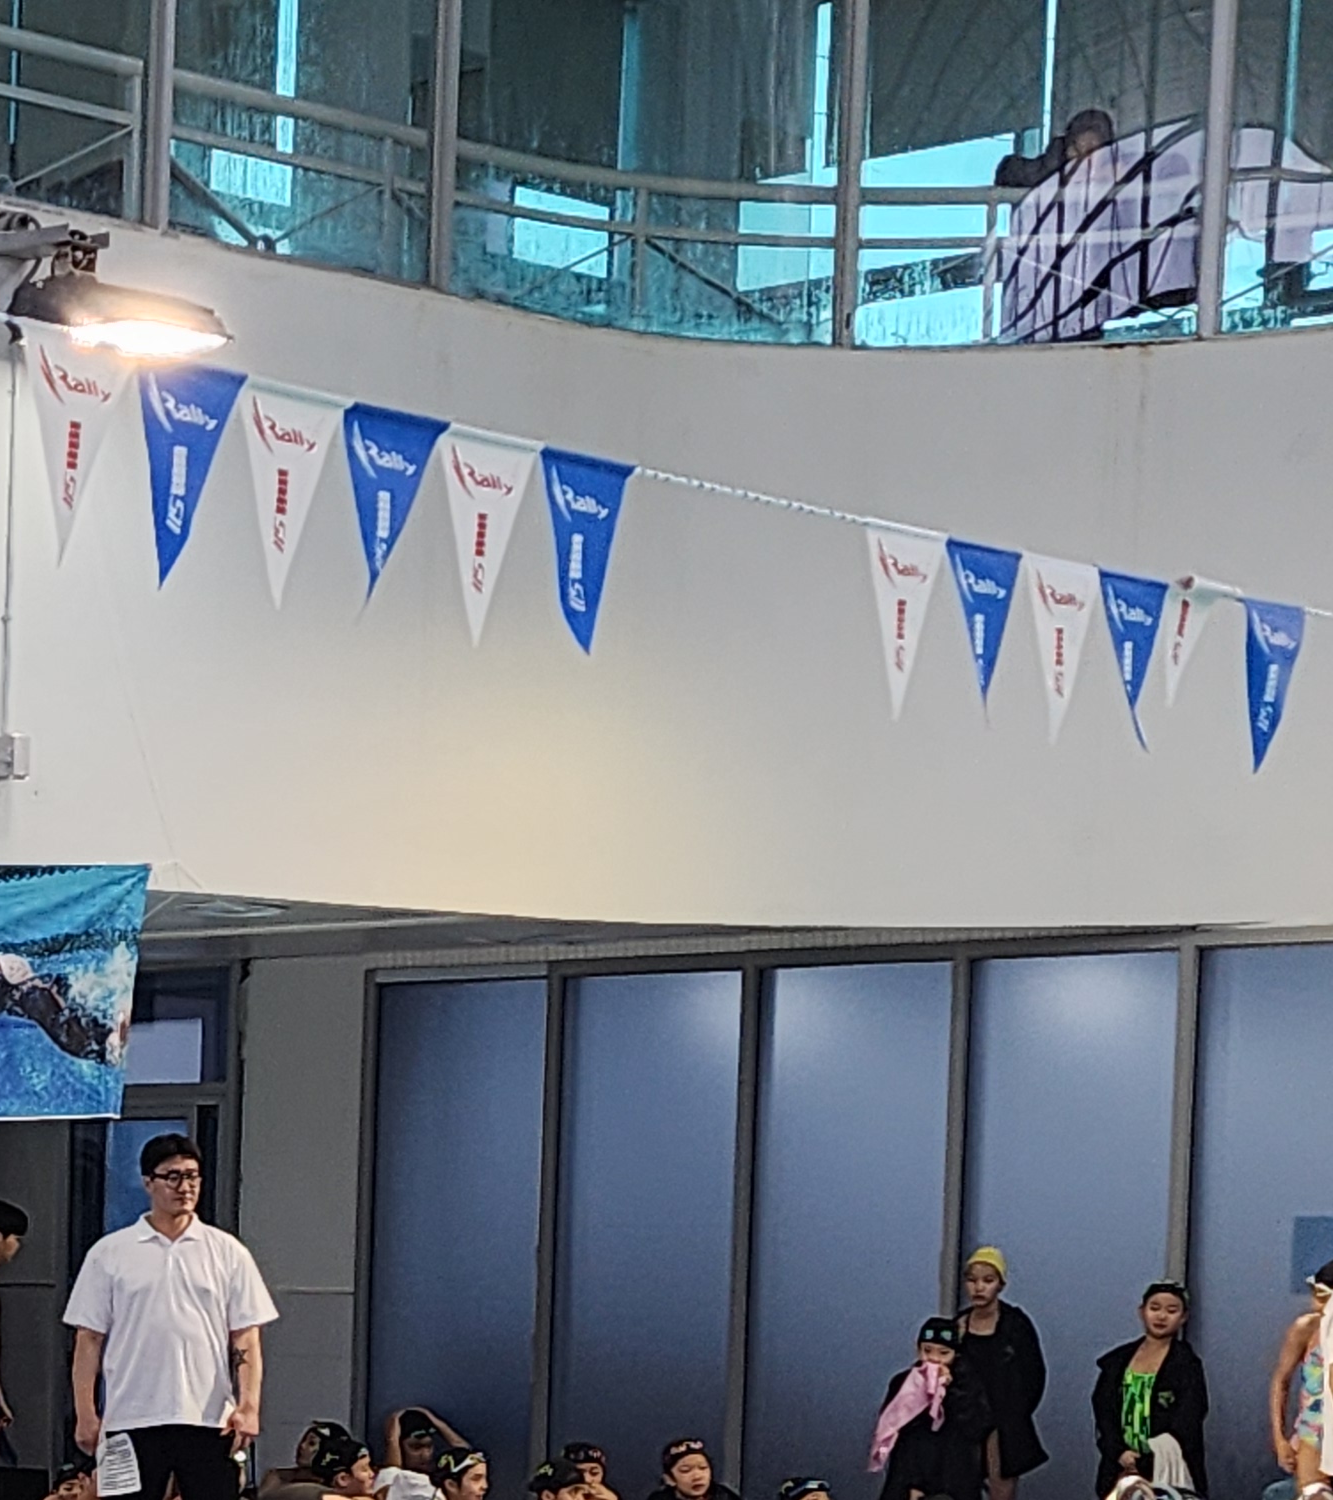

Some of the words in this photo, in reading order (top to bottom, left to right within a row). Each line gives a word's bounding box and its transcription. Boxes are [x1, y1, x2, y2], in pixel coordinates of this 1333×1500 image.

[53, 364, 112, 403] Rally
[161, 390, 219, 431] Rally
[264, 415, 318, 453] Rally
[463, 461, 514, 497] Rally
